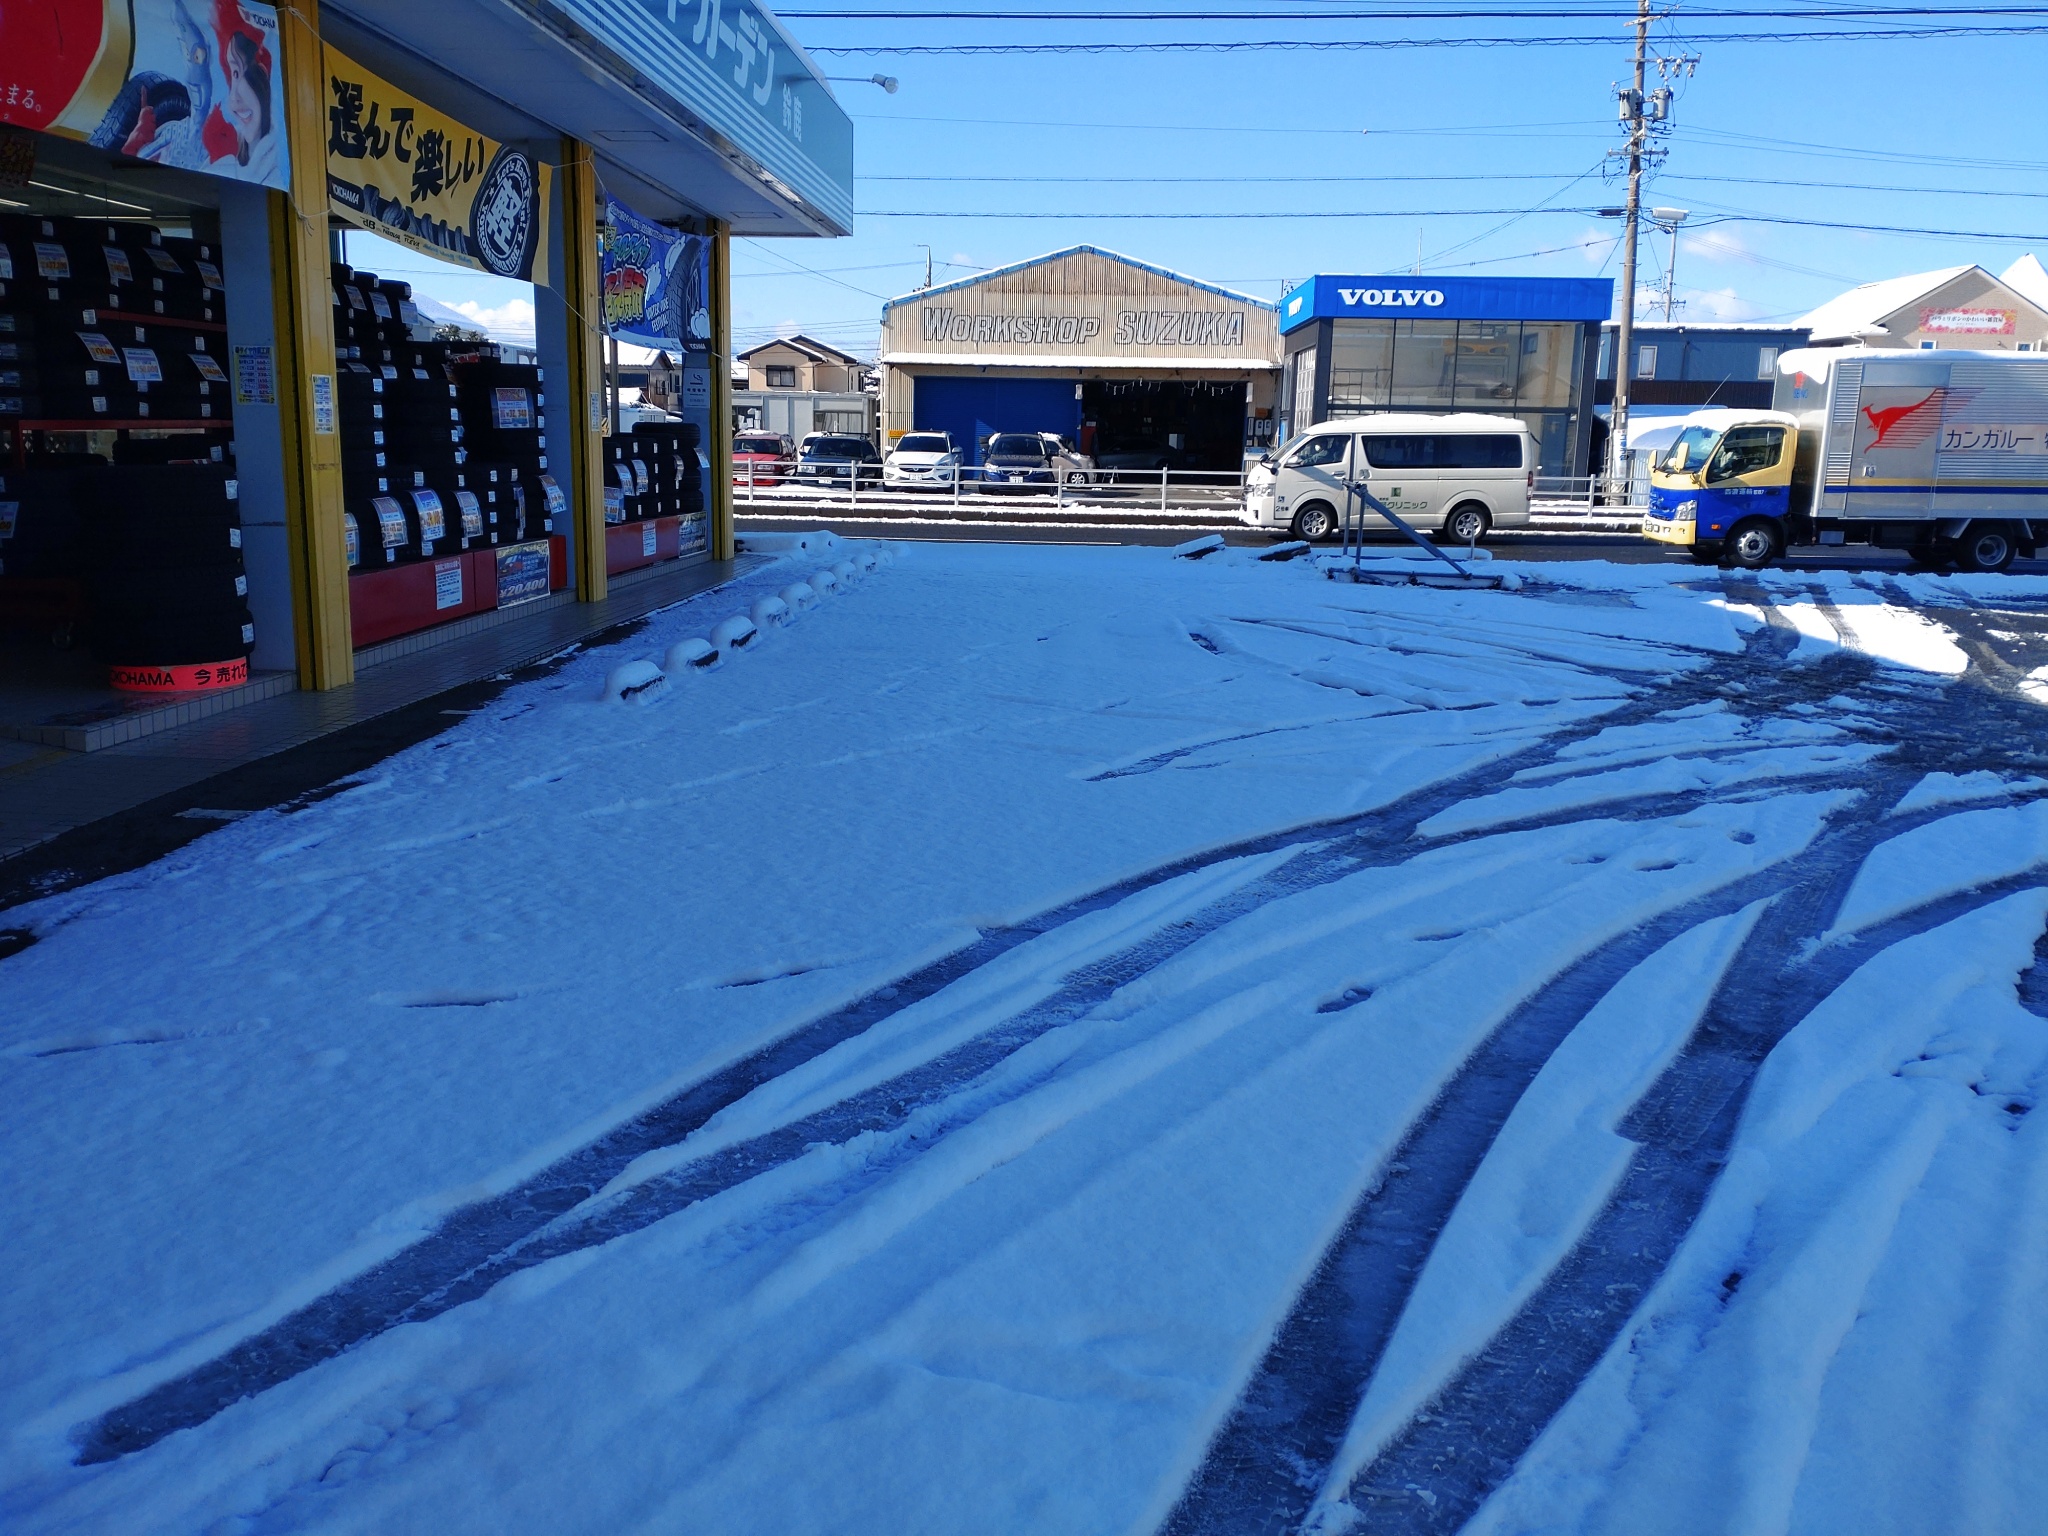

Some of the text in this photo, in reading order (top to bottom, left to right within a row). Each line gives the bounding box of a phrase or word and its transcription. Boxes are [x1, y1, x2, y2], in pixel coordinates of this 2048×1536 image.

[0, 83, 41, 113] まる。
[331, 182, 360, 205] YOKOHAMA
[1338, 288, 1444, 307] VOLVO
[923, 307, 1245, 346] WORKSHOP SUZUKA
[1945, 429, 2034, 449] カンガルー
[500, 577, 546, 599] ¥20,400
